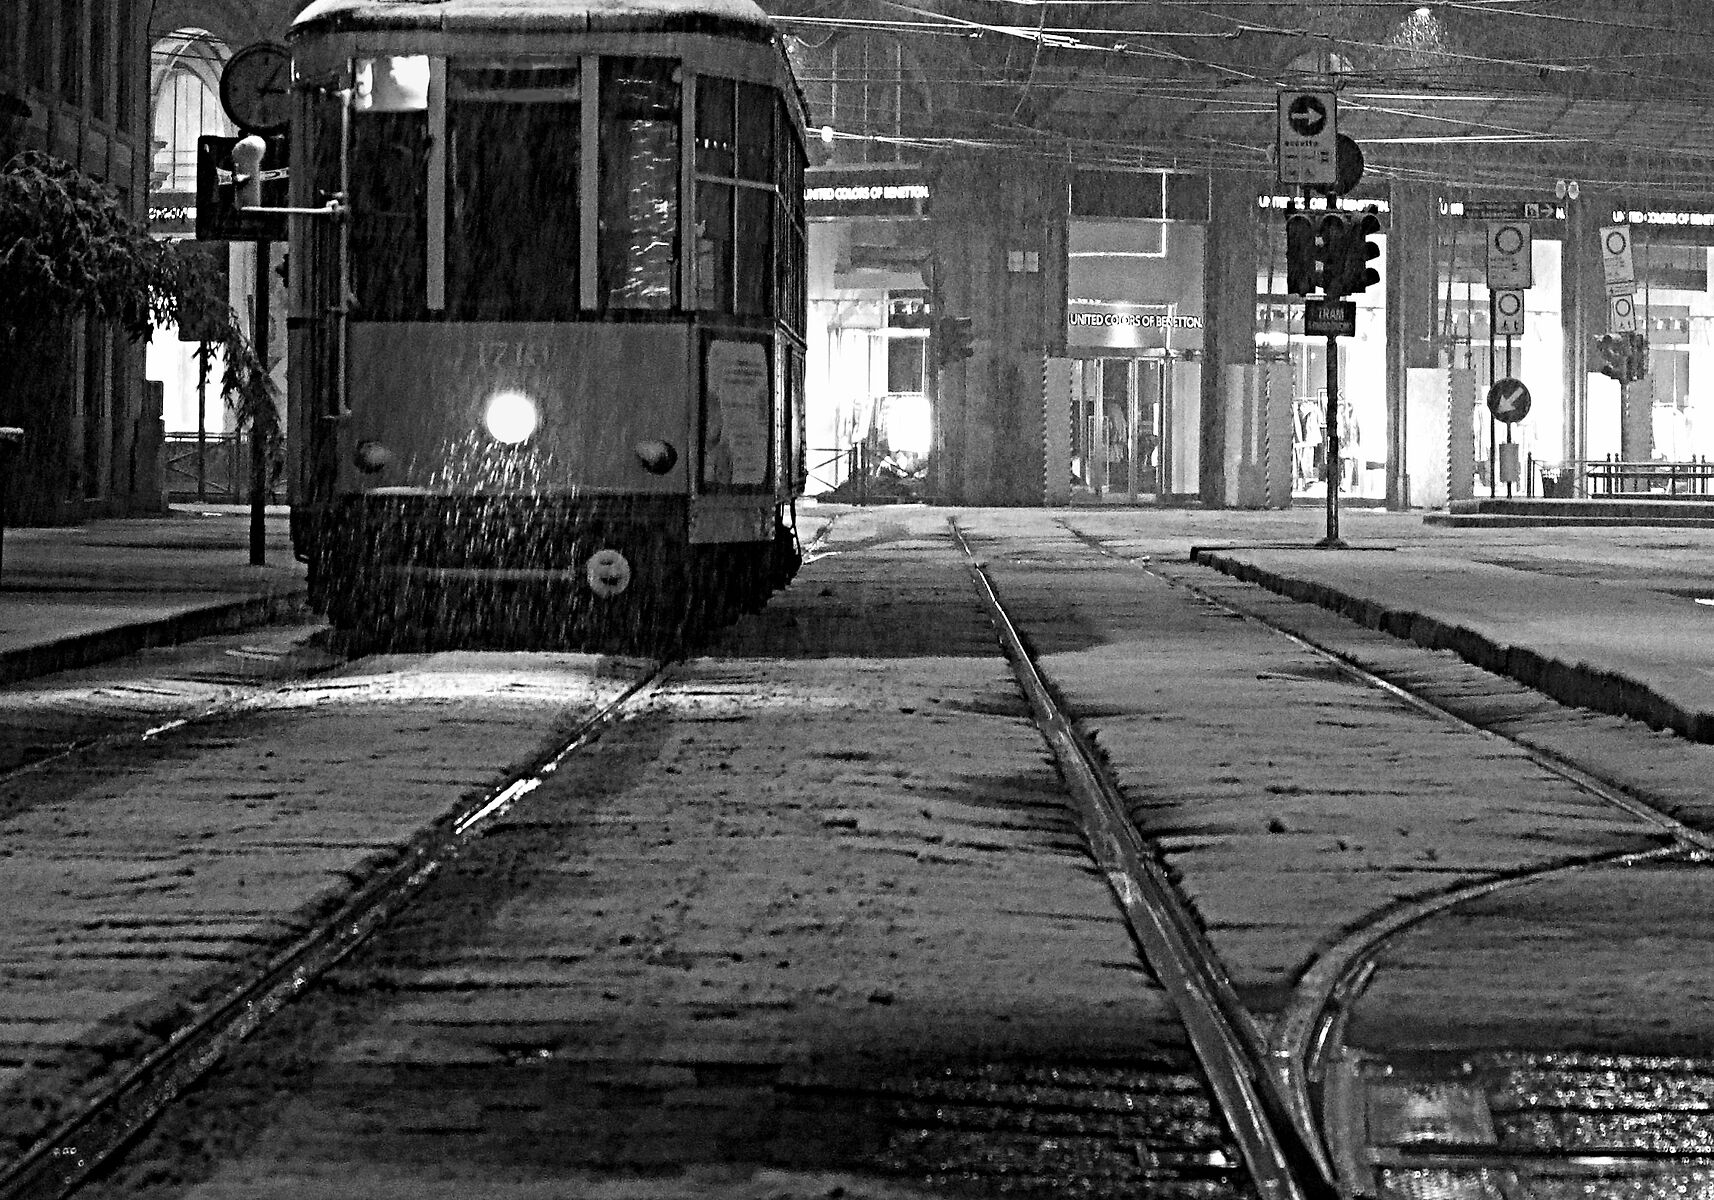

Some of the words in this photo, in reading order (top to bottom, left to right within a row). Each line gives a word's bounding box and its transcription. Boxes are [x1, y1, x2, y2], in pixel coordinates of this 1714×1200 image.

[1070, 313, 1104, 326] UNITED
[1104, 313, 1141, 326] COLORS
[1141, 314, 1155, 327] OF
